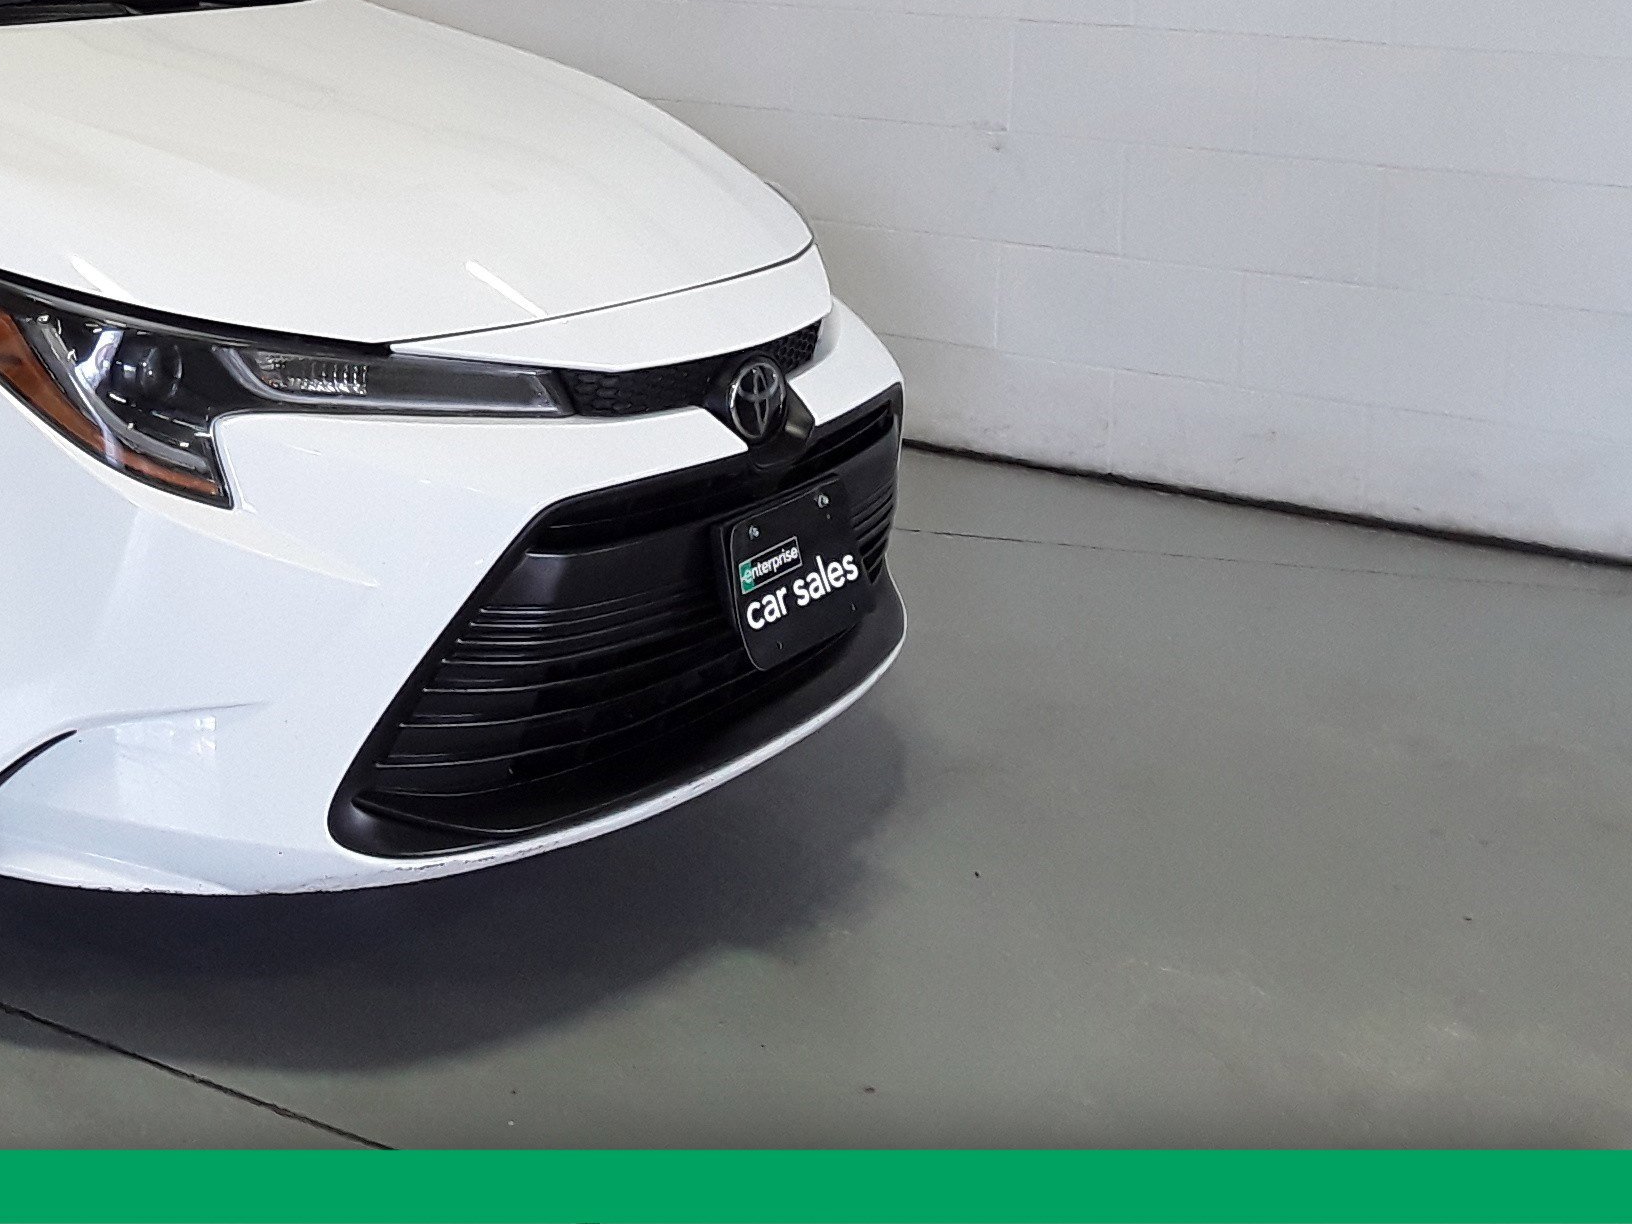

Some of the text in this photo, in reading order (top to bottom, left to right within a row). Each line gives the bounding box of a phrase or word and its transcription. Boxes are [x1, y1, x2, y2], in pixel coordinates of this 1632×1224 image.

[743, 546, 799, 582] enterprise
[746, 555, 859, 630] car sales
